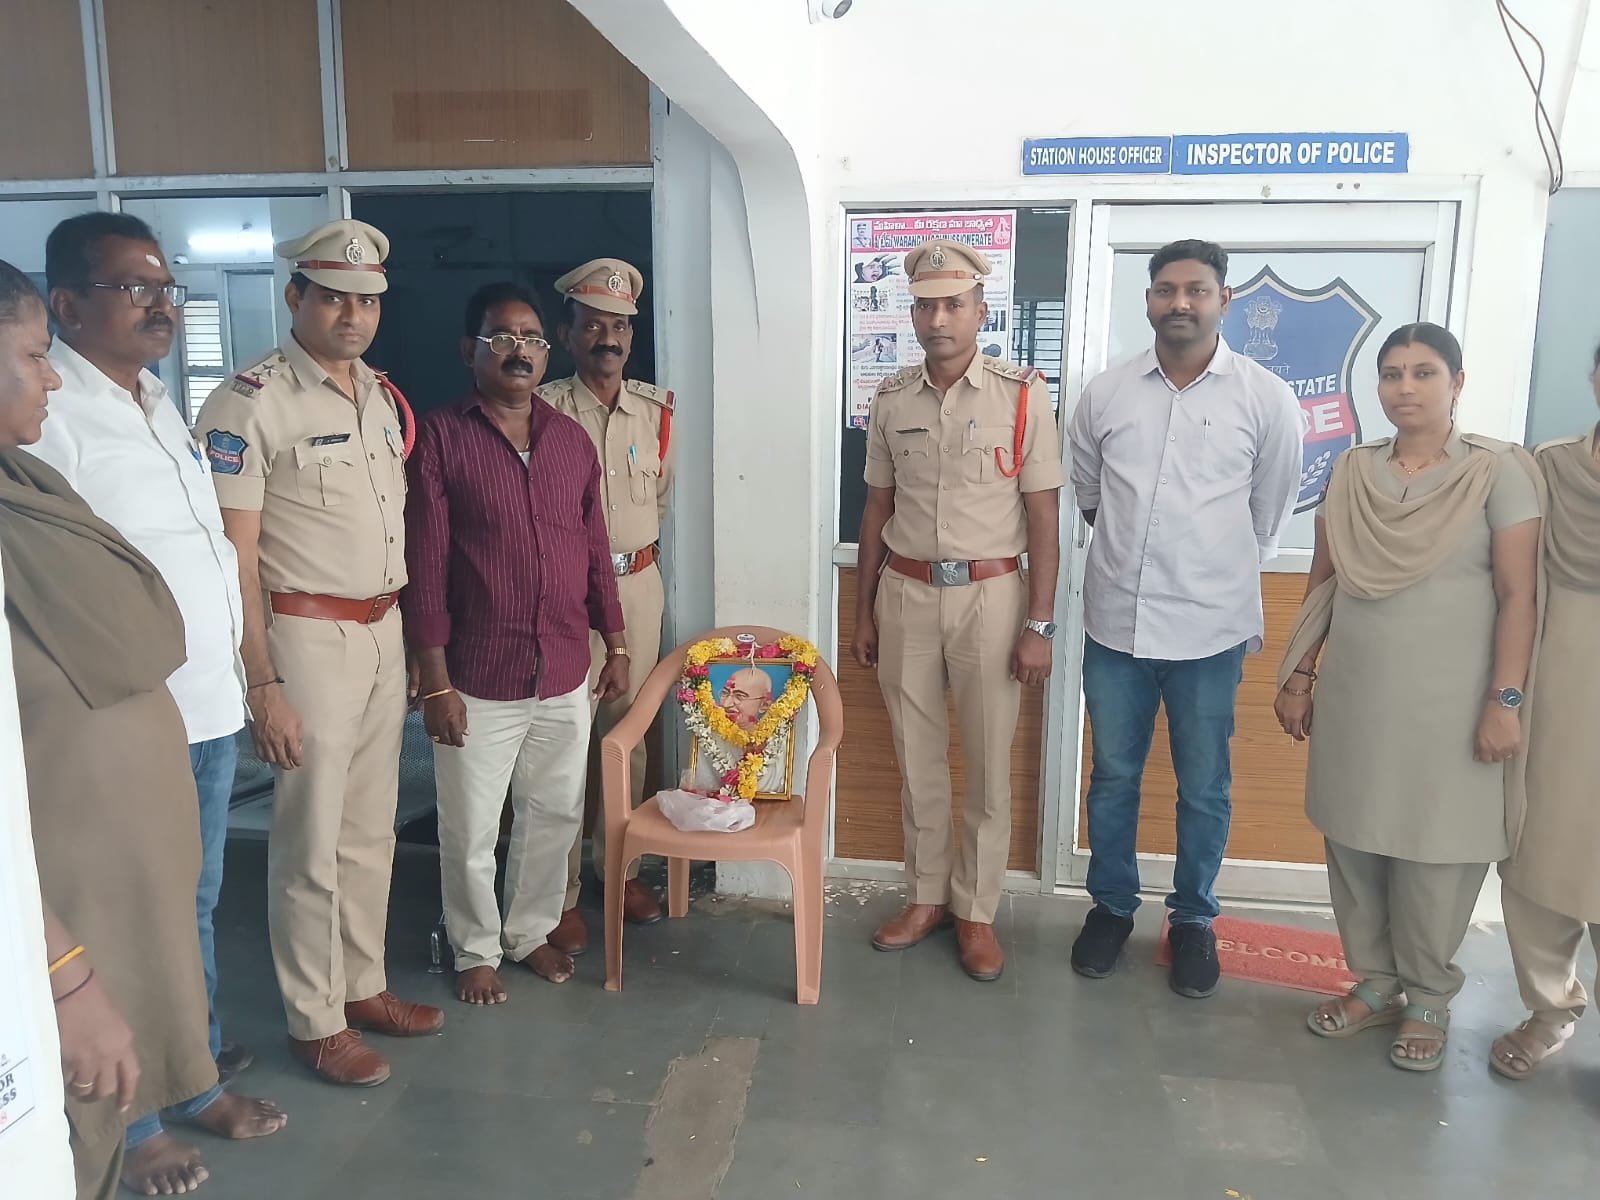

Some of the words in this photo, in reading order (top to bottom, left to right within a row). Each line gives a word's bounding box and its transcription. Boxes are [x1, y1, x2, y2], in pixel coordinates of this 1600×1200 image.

[1030, 147, 1076, 165] STATION
[1079, 146, 1116, 165] HOUSE
[1119, 146, 1162, 164] OFFICER
[1187, 143, 1292, 165] INSPECTOR
[1297, 143, 1322, 165] OF
[1327, 142, 1395, 164] POLICE
[1216, 939, 1349, 971] ELCOM
